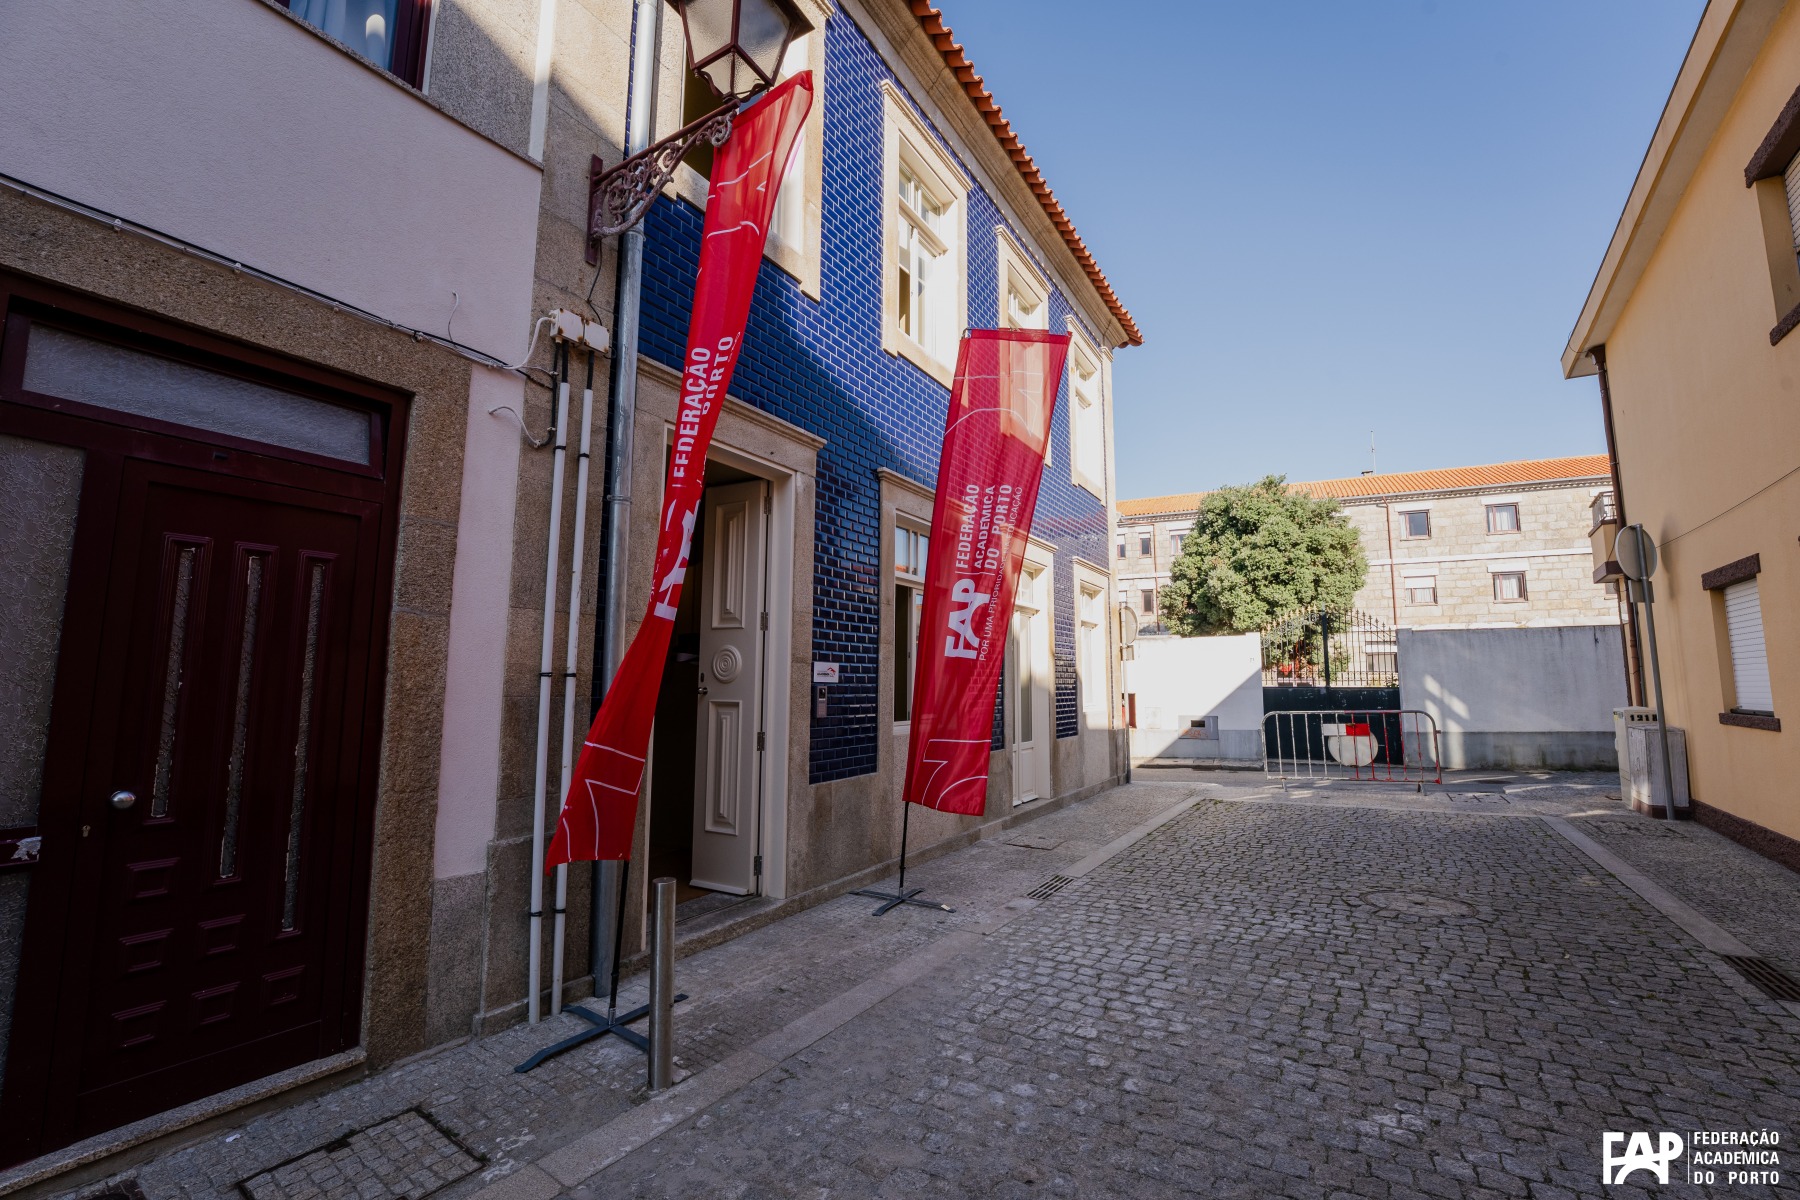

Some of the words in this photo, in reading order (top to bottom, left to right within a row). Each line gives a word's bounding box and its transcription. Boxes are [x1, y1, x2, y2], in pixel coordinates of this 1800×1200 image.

[955, 484, 980, 569] FEDERAÇÃO
[991, 484, 1012, 535] PORTO
[984, 547, 1000, 570] DO
[944, 578, 991, 660] FAP
[983, 615, 995, 637] UMA
[979, 639, 990, 661] POR
